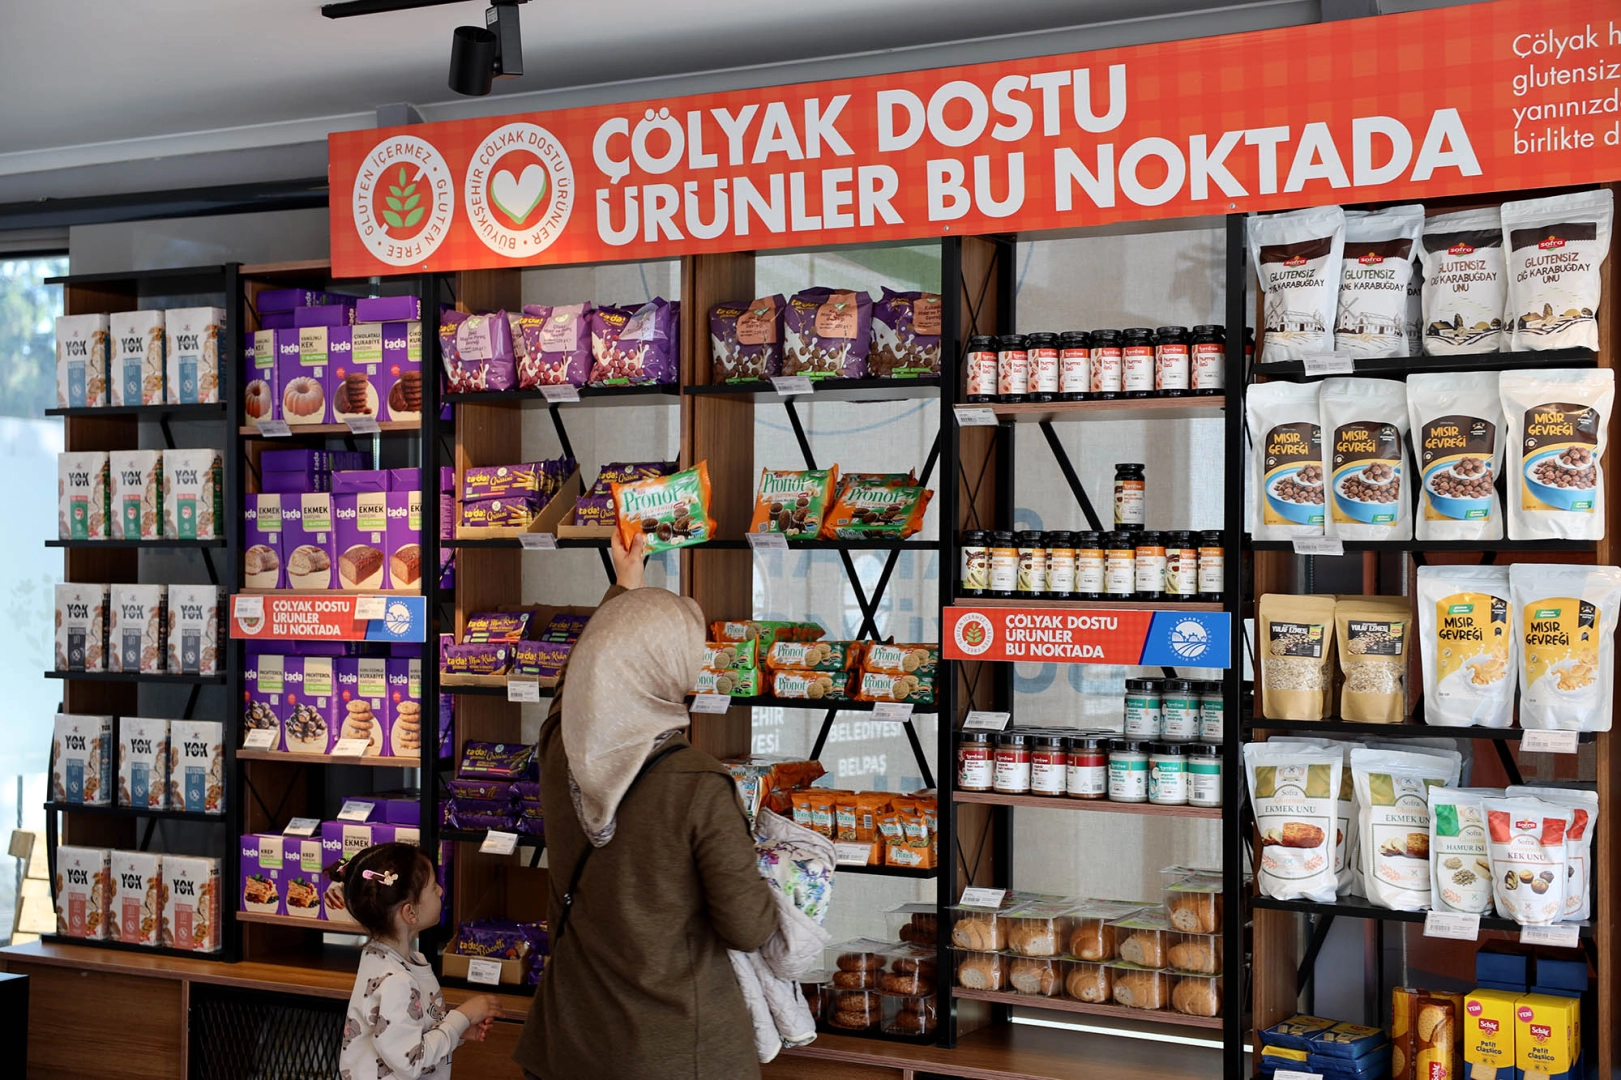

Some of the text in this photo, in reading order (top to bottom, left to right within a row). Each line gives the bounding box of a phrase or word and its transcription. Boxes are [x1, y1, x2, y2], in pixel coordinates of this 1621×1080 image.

[1512, 24, 1599, 59] Çölyak
[1512, 59, 1620, 96] glutensiz
[1512, 87, 1621, 129] yanınızd
[593, 63, 1126, 184] ÇÖLYAK DOSTU
[1513, 126, 1595, 154] birlikte
[596, 107, 1482, 245] ÜRÜNLER BU NOKTADA
[358, 143, 432, 236] GLUTEN İÇERMEZ
[471, 130, 571, 250] BÜYÜKŞEHİR ÇÖLYAK DOSTU ÜRÜNLER
[387, 179, 448, 258] GLUTEN FREE
[1540, 240, 1563, 248] sofra
[1525, 252, 1579, 269] GLUTENSİZ
[1269, 268, 1316, 283] GLUTENSİZ
[1344, 269, 1396, 281] GLUTENSİZ
[1439, 271, 1497, 283] KARABUĞDAY
[1529, 263, 1590, 279] KARABUĞDAY
[1339, 280, 1405, 291] ANE KARABUĞDAY
[1542, 275, 1560, 284] UNU
[1452, 283, 1469, 293] UNU
[65, 340, 87, 356] YOK
[121, 337, 143, 354] YOK
[176, 334, 199, 351] YOK
[281, 343, 299, 354] tada
[331, 341, 351, 351] tada
[385, 339, 406, 349] tada
[1534, 413, 1564, 424] MISIR
[1274, 432, 1301, 444] MISIR
[1342, 430, 1368, 441] MISIR
[1430, 426, 1459, 438] MISIR
[68, 472, 89, 487] YOK
[121, 471, 142, 486] YOK
[175, 469, 198, 485] YOK
[763, 473, 808, 493] Pronot
[624, 486, 682, 513] Pronot
[848, 488, 900, 503] Pronot
[282, 509, 301, 519] tada
[337, 508, 356, 518] tada
[388, 507, 407, 517] tada
[67, 604, 89, 619] YOK
[121, 604, 144, 620] YOK
[180, 604, 203, 620] YOK
[273, 600, 350, 613] ÇÖLYAK DOSTU
[273, 612, 319, 624] ÜRÜNLER
[1005, 614, 1118, 631] ÇÖLYAK DOSTU
[1444, 617, 1474, 629] MISIR
[273, 624, 341, 636] BU NOKTADA
[1531, 621, 1560, 633] MISIR
[1005, 628, 1073, 643] ÜRÜNLER
[777, 644, 804, 658] Pronot
[874, 647, 902, 662] Pronot
[1005, 643, 1104, 658] BU NOKTADA
[285, 671, 303, 682] tada
[339, 672, 357, 683] tada
[389, 674, 408, 684] tada
[778, 677, 806, 691] Pronot
[864, 673, 891, 688] Pronot
[65, 735, 86, 751] YOK
[130, 739, 152, 754] YOK
[184, 742, 208, 758] YOK
[838, 754, 887, 777] BELPAŞ
[1281, 789, 1298, 797] Sofra
[1403, 799, 1420, 807] Sofra
[1385, 814, 1416, 823] EKMEK
[1465, 829, 1482, 837] Sofra
[323, 839, 369, 849] tada EKMEK
[242, 848, 258, 857] tada
[285, 851, 300, 860] tada
[67, 869, 88, 885] YOK
[121, 873, 142, 890] YOK
[173, 879, 195, 897] YOK
[1476, 1046, 1502, 1055] Classico
[1528, 1052, 1555, 1061] Classico
